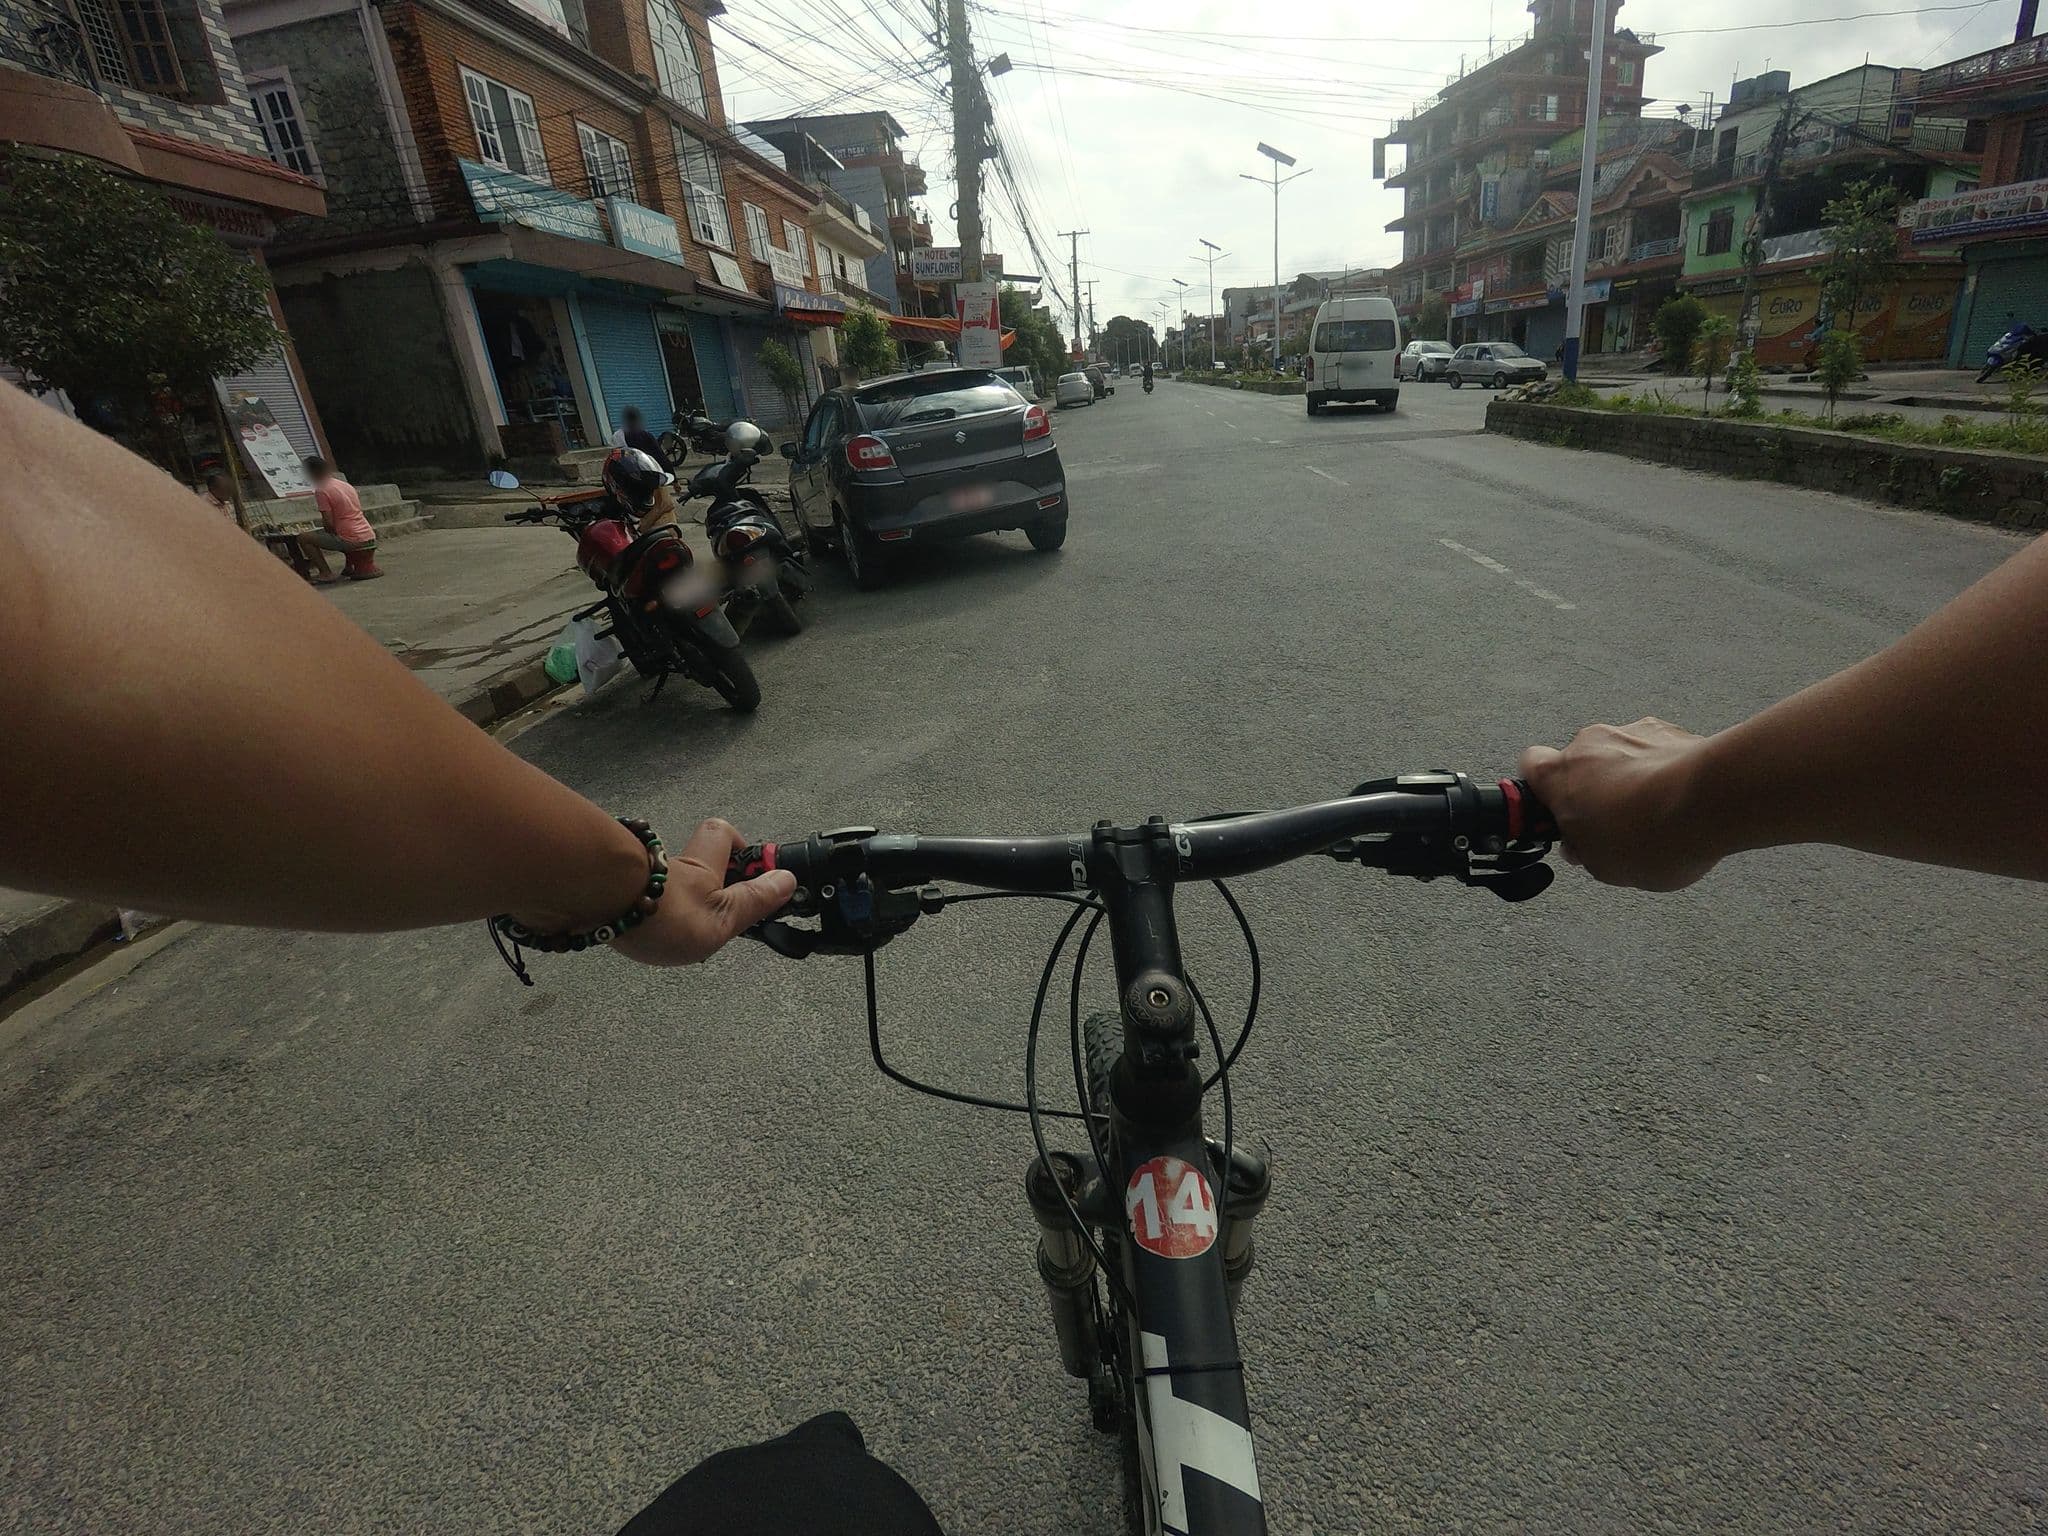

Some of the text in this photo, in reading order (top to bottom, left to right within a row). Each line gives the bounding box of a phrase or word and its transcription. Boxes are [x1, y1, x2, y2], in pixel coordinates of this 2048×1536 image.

[924, 250, 948, 260] HOTEL
[915, 262, 960, 274] SUNFLOWER
[1126, 1171, 1212, 1240] 14
